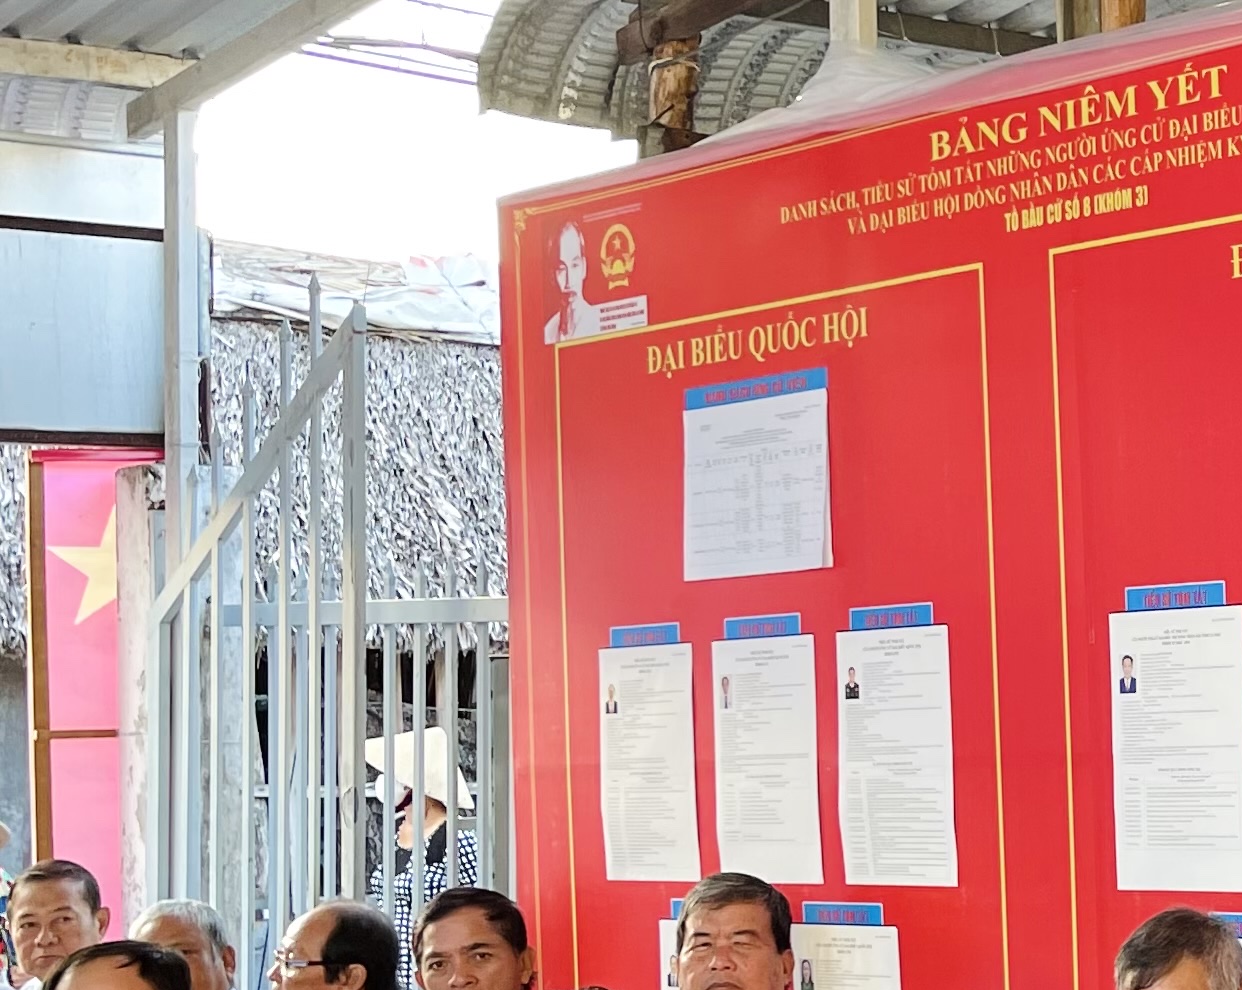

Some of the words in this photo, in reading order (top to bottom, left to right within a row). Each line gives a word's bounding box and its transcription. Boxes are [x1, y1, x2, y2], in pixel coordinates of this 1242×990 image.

[929, 116, 1029, 162] BẢNG
[1038, 85, 1139, 138] NIÊM
[1146, 62, 1228, 111] YẾT
[780, 200, 817, 224] DANH
[897, 172, 917, 198] SỬ
[918, 167, 951, 193] TÓM
[986, 149, 1041, 179] NHỮNG
[1045, 133, 1097, 166] NGƯỜI
[1101, 127, 1137, 153] ỨNG
[1140, 117, 1165, 145] CỬ
[1169, 115, 1198, 142] ĐẠI
[1202, 102, 1242, 132] BIỂU
[848, 209, 867, 235] VÀ
[933, 193, 960, 220] HỘI
[1009, 171, 1053, 202] NHÂN
[1056, 164, 1089, 192] DÂN
[1092, 156, 1126, 184] CÁC
[1166, 139, 1222, 169] NHIỆM
[647, 340, 685, 379] ĐẠI
[690, 324, 743, 367] BIỂU
[749, 311, 817, 362] QUỐC
[822, 304, 868, 348] HỘI
